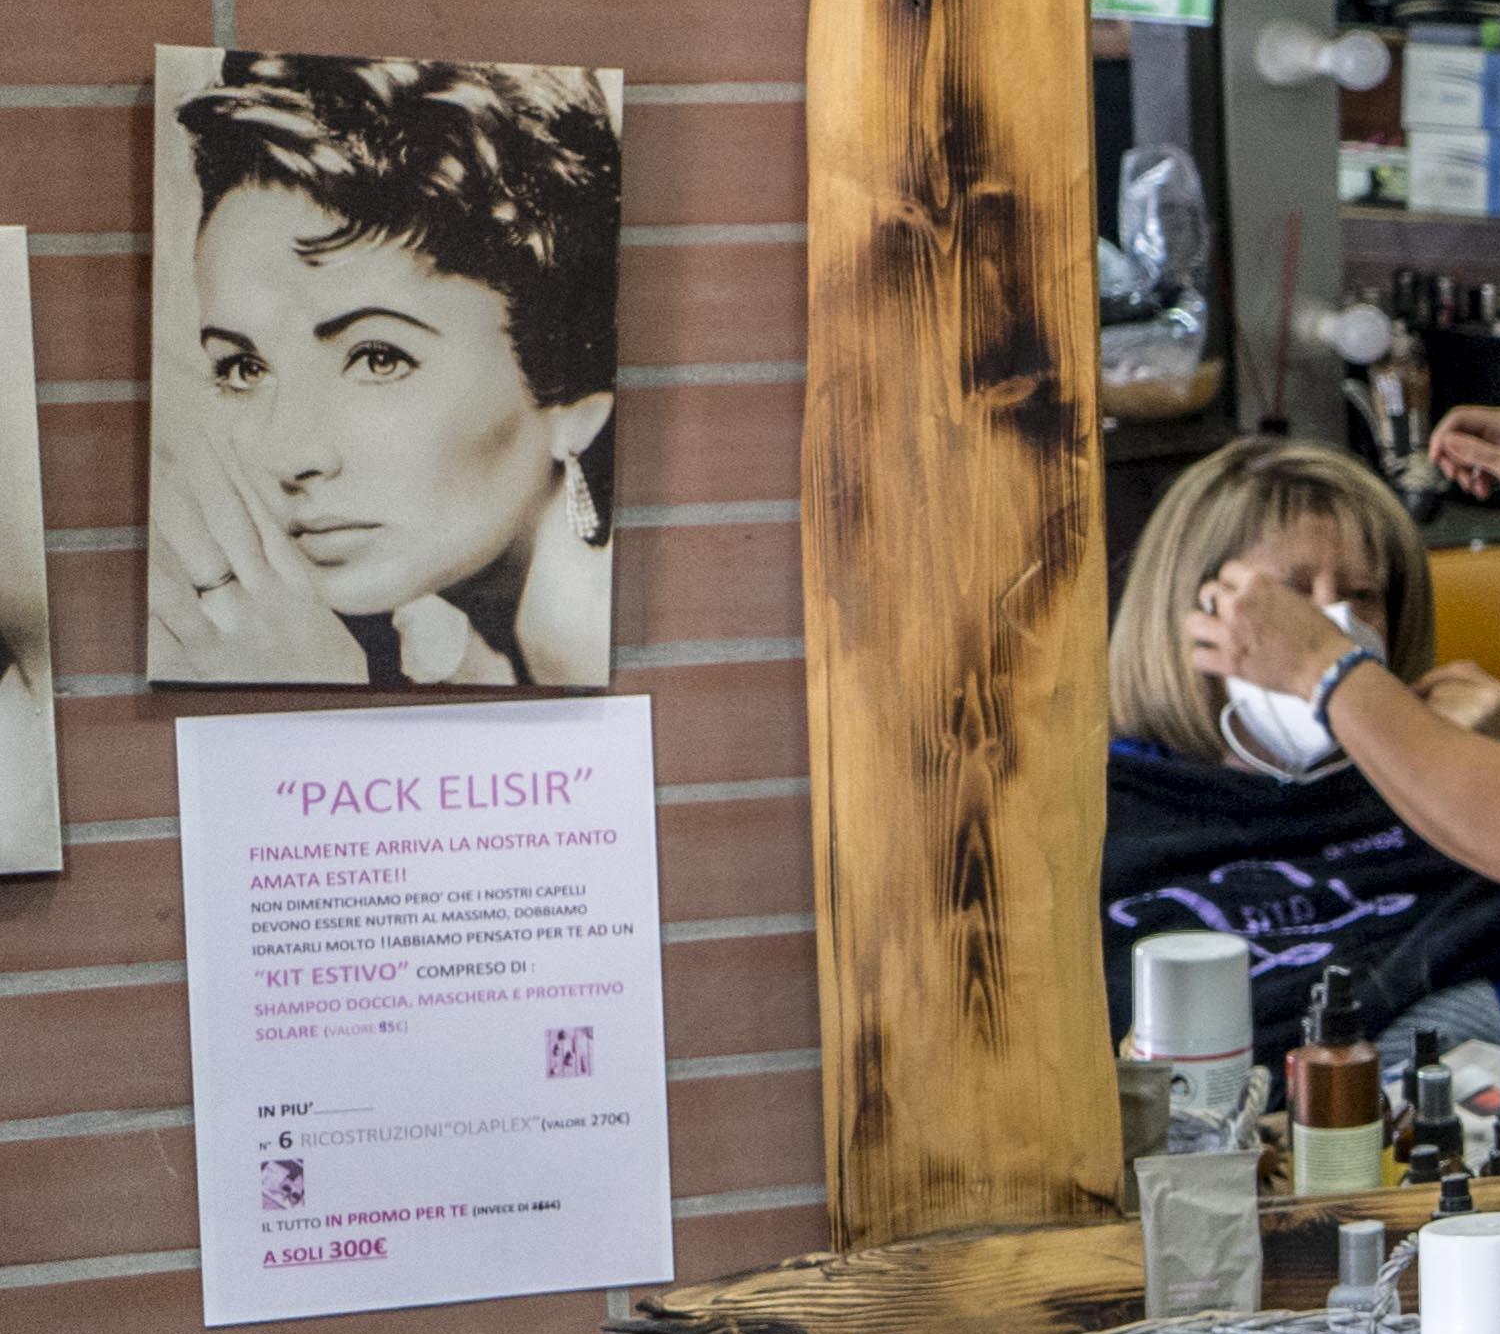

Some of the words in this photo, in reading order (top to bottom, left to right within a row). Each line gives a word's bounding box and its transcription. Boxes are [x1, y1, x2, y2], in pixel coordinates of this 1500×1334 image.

[249, 841, 370, 862] FINALMENTE
[375, 838, 444, 856] ARRIVA
[449, 836, 471, 852] LA
[476, 832, 550, 851] NOSTRA
[556, 828, 618, 847] TANTO
[250, 871, 320, 890] AMATA
[250, 900, 282, 914] NON
[286, 893, 402, 912] DIMENTICHIAMO
[447, 889, 474, 903] CHE
[484, 886, 533, 901] NOSTRI
[535, 884, 587, 897] CAPELLI
[251, 919, 311, 934] DEVONO
[314, 916, 361, 930] ESSERE
[365, 913, 419, 927] NUTRITI
[422, 912, 438, 924] AL
[514, 903, 589, 919] DOBBIAMO
[325, 937, 376, 952] MOLTO
[466, 928, 533, 945] PENSATO
[536, 926, 564, 940] PER
[567, 925, 583, 938] TE
[587, 923, 608, 937] AD
[612, 922, 635, 935] UN
[416, 961, 507, 980] COMPRESO
[511, 961, 527, 973] DI
[254, 998, 342, 1018] SHAMPOO
[418, 988, 508, 1008] MASCHERA
[512, 987, 522, 1001] E
[526, 980, 626, 1000] PROTETTIVO
[254, 1024, 319, 1042] SOLARE
[257, 1104, 276, 1119] IN
[278, 1130, 294, 1150] 6
[300, 1121, 443, 1148] RICOSTRUZIONI
[261, 1222, 272, 1233] IL
[276, 1217, 322, 1232] TUTTO
[325, 1213, 343, 1228] IN
[347, 1208, 411, 1226] PROMO
[415, 1205, 446, 1220] PER
[450, 1203, 468, 1217] TE
[517, 1202, 529, 1212] DI
[262, 1250, 277, 1265] A
[281, 1246, 323, 1264] SOLI
[328, 1236, 388, 1260] 300€
